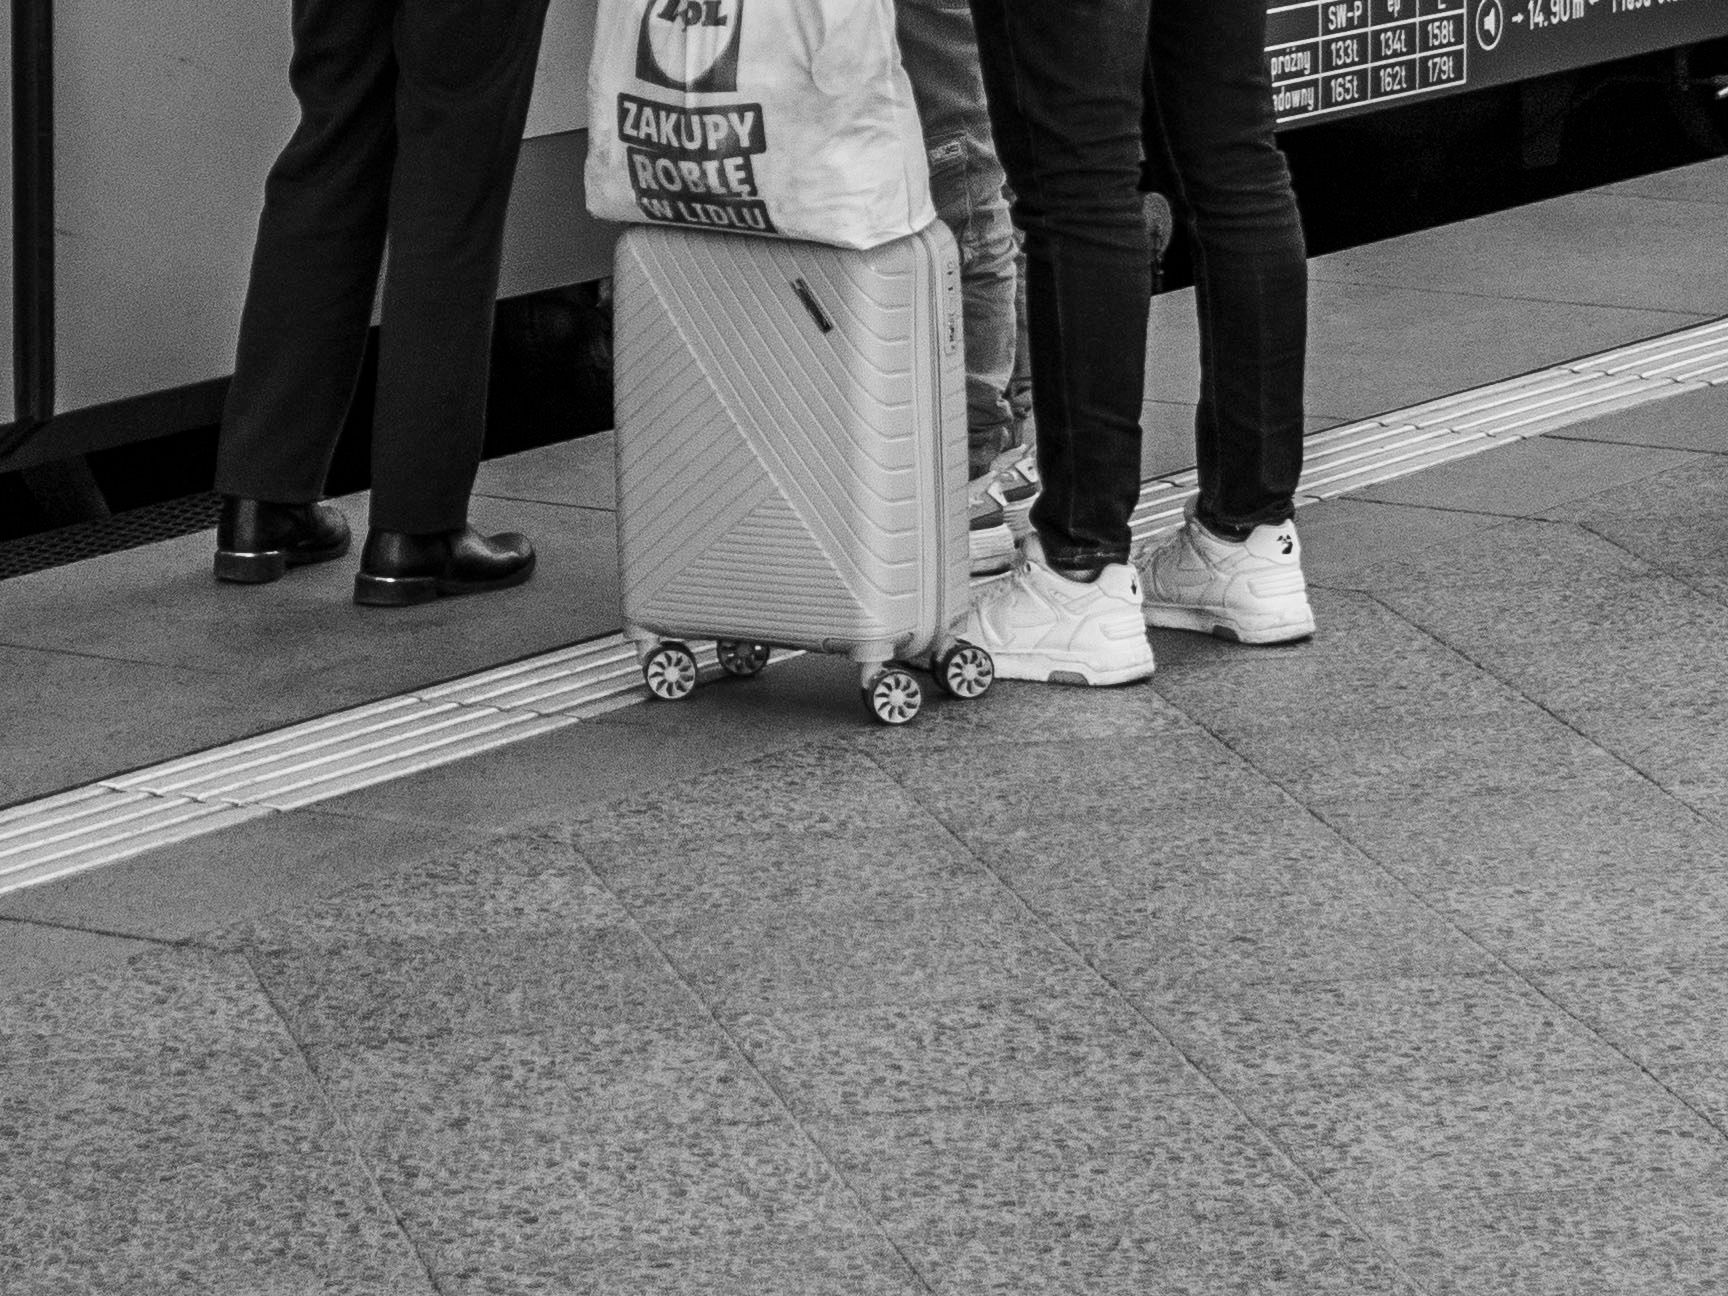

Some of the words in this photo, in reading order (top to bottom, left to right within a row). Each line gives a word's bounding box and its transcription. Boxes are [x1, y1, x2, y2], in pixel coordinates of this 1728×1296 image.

[1328, 0, 1363, 31] SW-P
[1330, 39, 1359, 67] 133t
[1380, 30, 1407, 56] 134t
[1427, 20, 1455, 47] 158t
[1272, 86, 1315, 113] adowny
[1331, 76, 1359, 103] 165t
[1380, 66, 1407, 93] 162t
[1427, 56, 1455, 82] 179t
[622, 100, 755, 151] ZAKUPY
[631, 153, 753, 198] ROBIĘ
[676, 200, 767, 230] LIDLU
